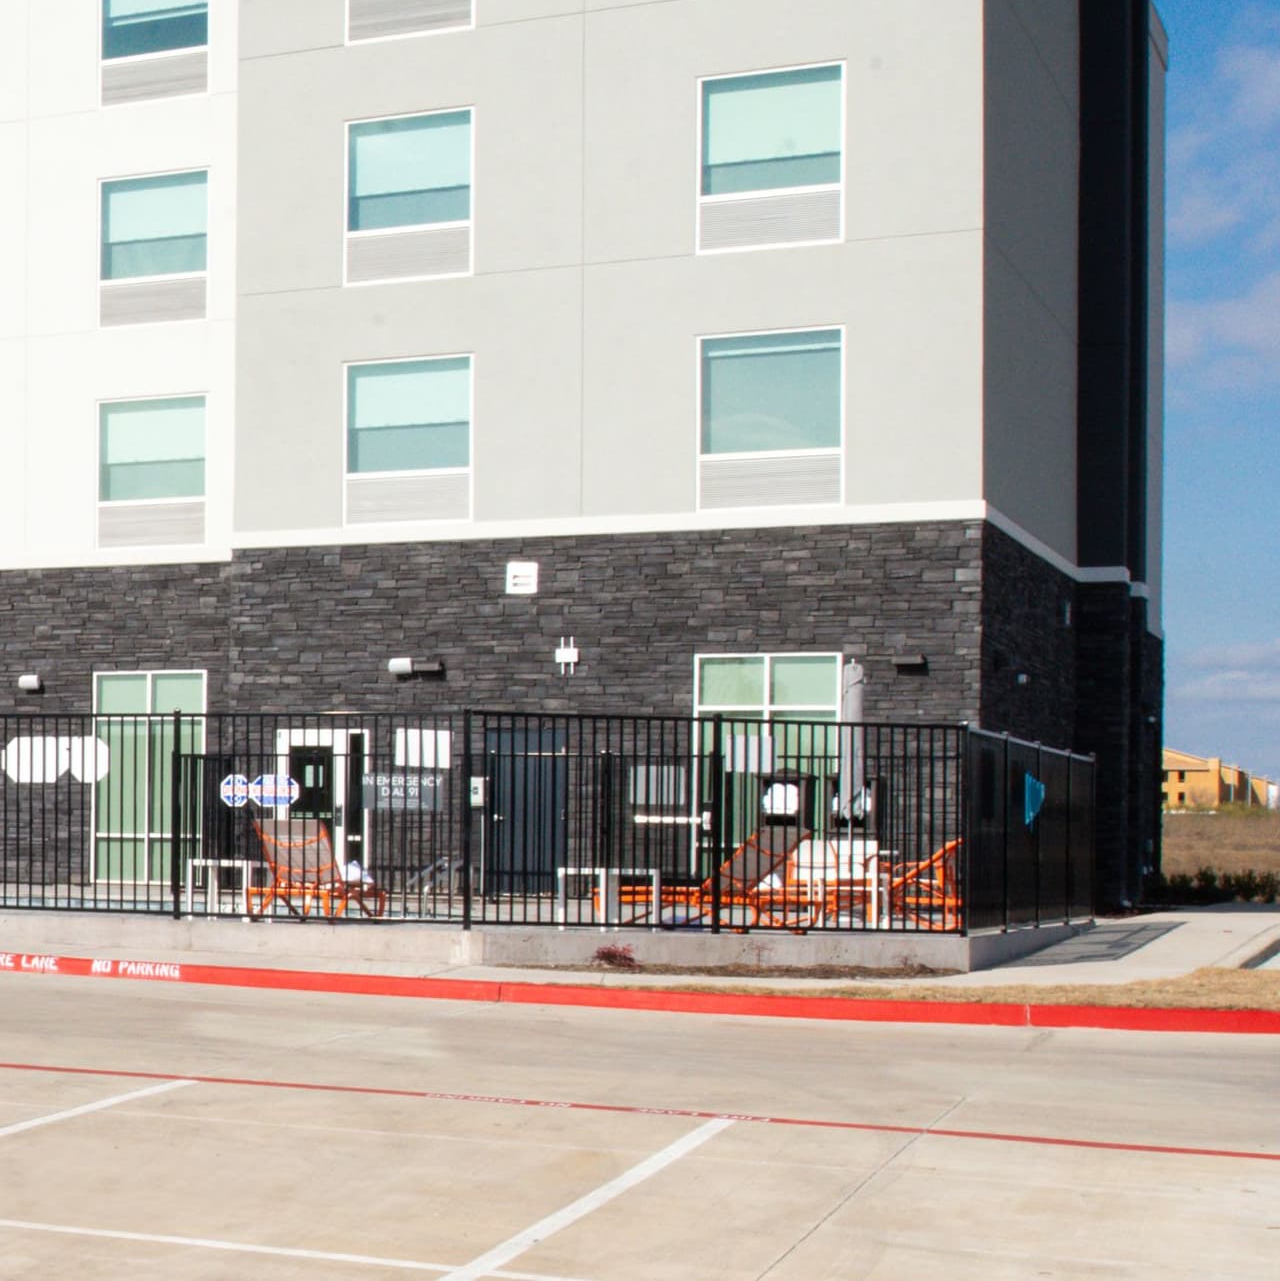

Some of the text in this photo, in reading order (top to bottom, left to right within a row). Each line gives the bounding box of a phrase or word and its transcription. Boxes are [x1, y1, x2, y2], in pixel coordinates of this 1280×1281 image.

[381, 787, 405, 797] DAL
[21, 955, 59, 971] LANE
[91, 959, 180, 978] NO PARKING
